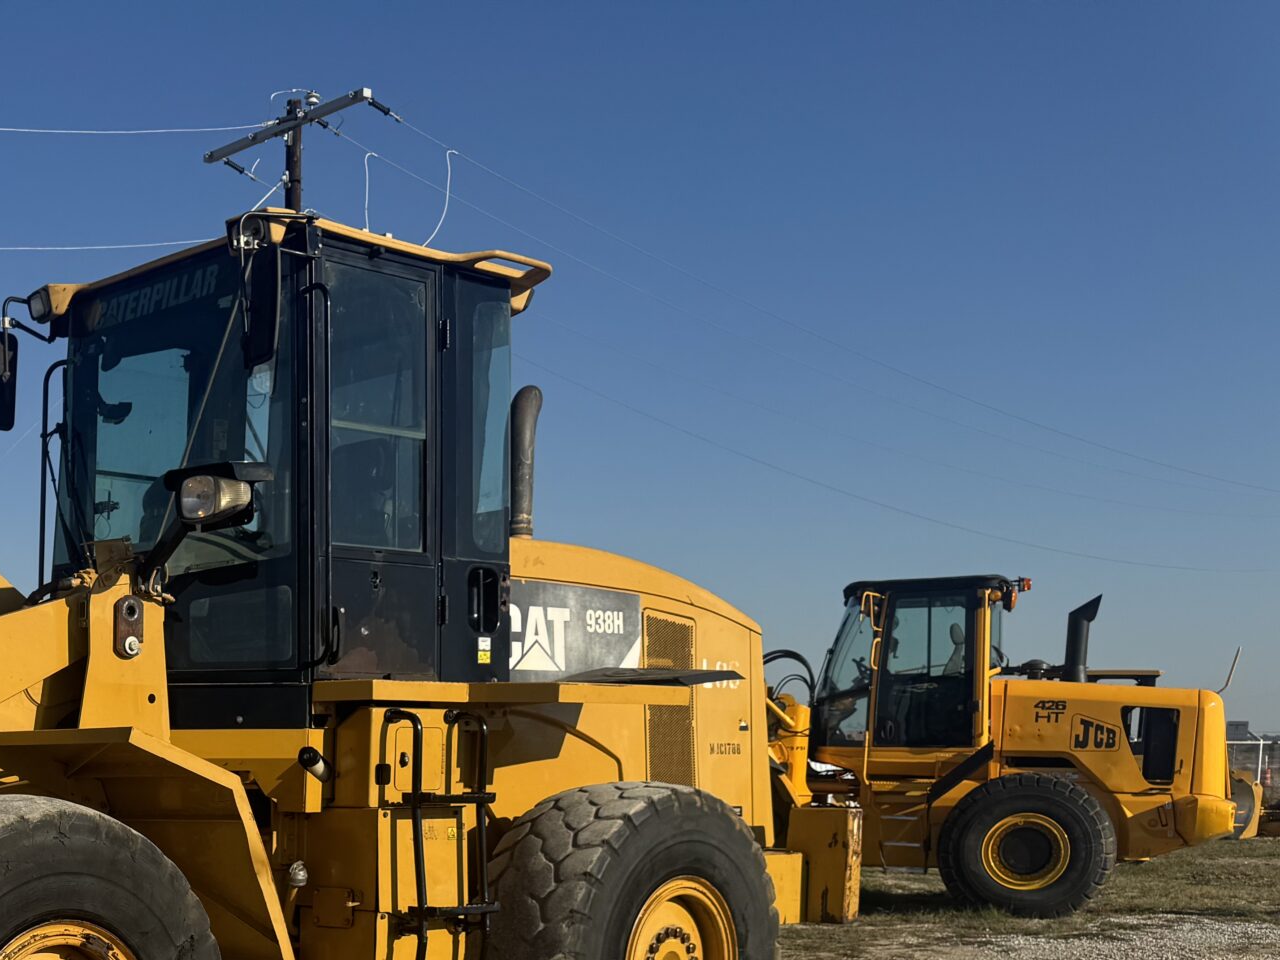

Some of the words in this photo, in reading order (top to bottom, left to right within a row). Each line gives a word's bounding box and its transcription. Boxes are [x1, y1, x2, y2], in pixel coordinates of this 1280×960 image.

[91, 264, 219, 330] CATERPILLAR
[586, 610, 624, 634] 938H
[1034, 700, 1067, 711] 426
[1035, 711, 1064, 723] HT
[1074, 718, 1116, 749] JCB
